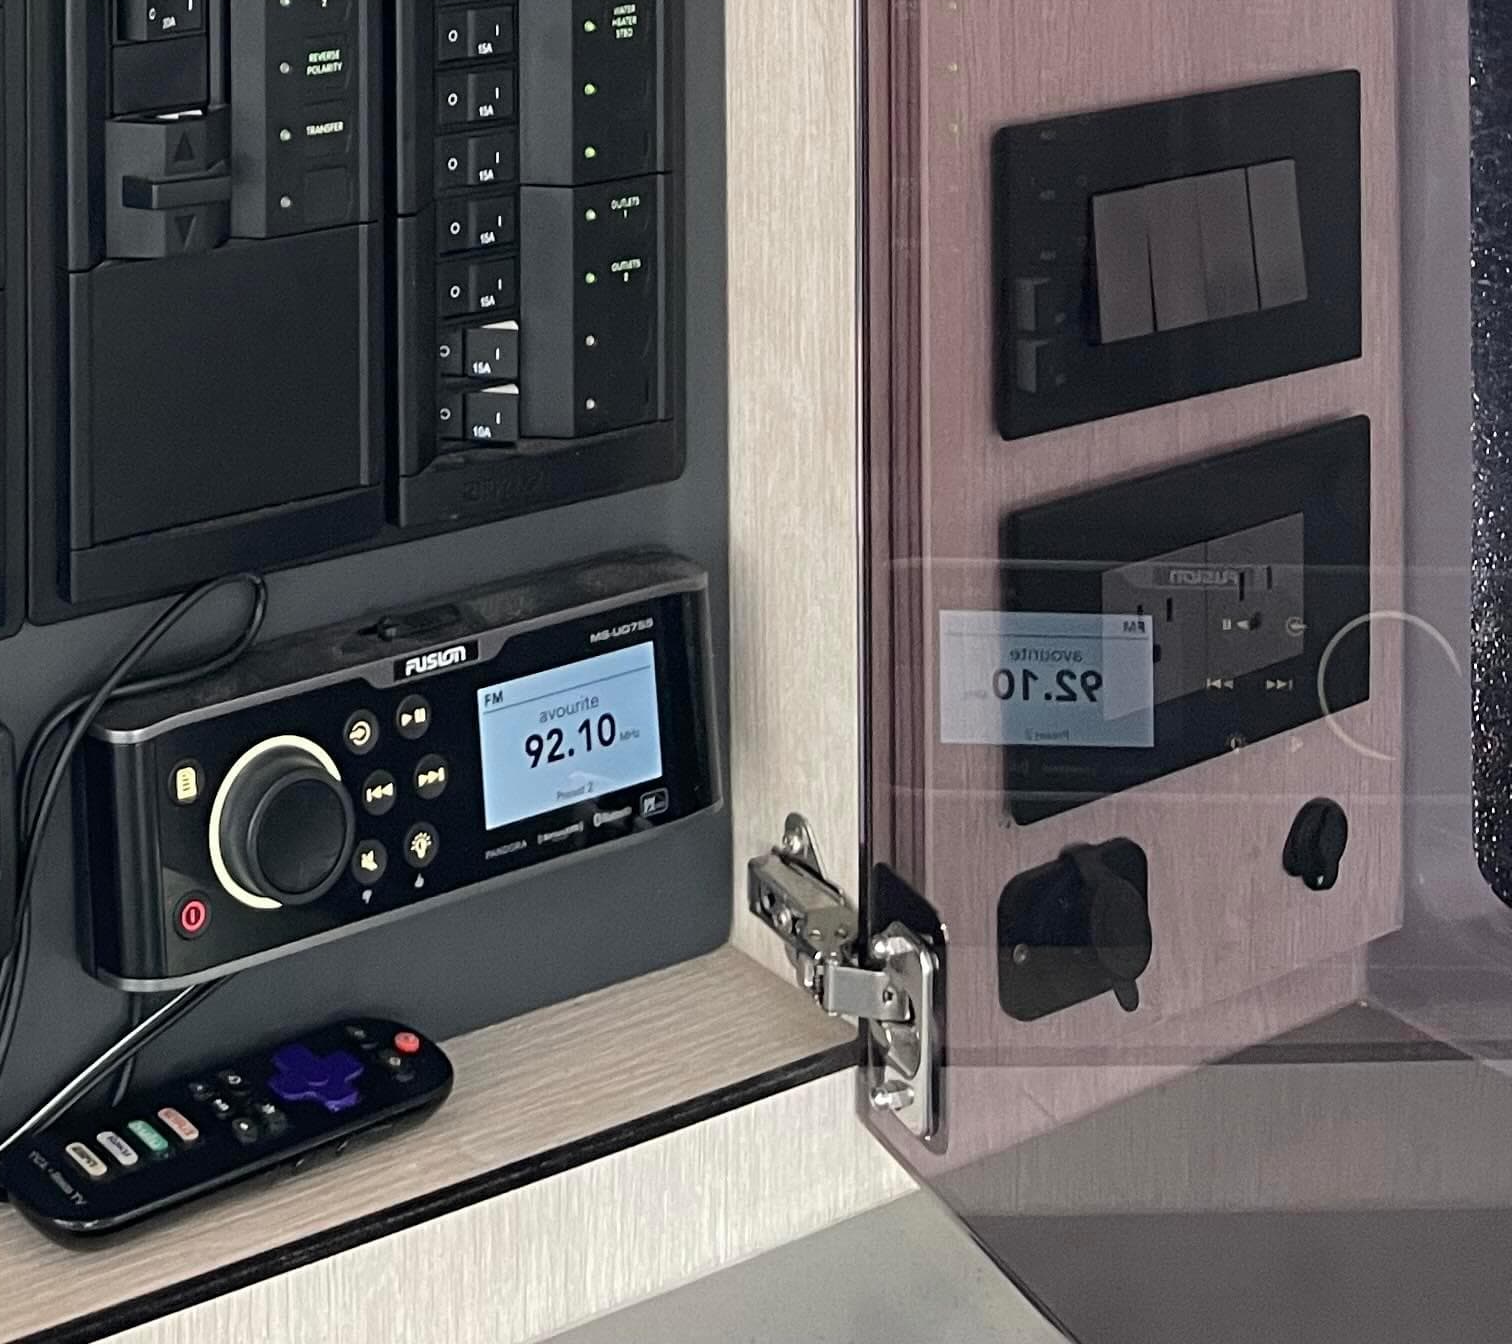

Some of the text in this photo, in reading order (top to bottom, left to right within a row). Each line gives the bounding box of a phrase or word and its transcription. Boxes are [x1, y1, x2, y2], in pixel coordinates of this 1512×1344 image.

[484, 691, 503, 707] FM
[539, 694, 599, 723] avourite
[525, 713, 616, 769] 92.10
